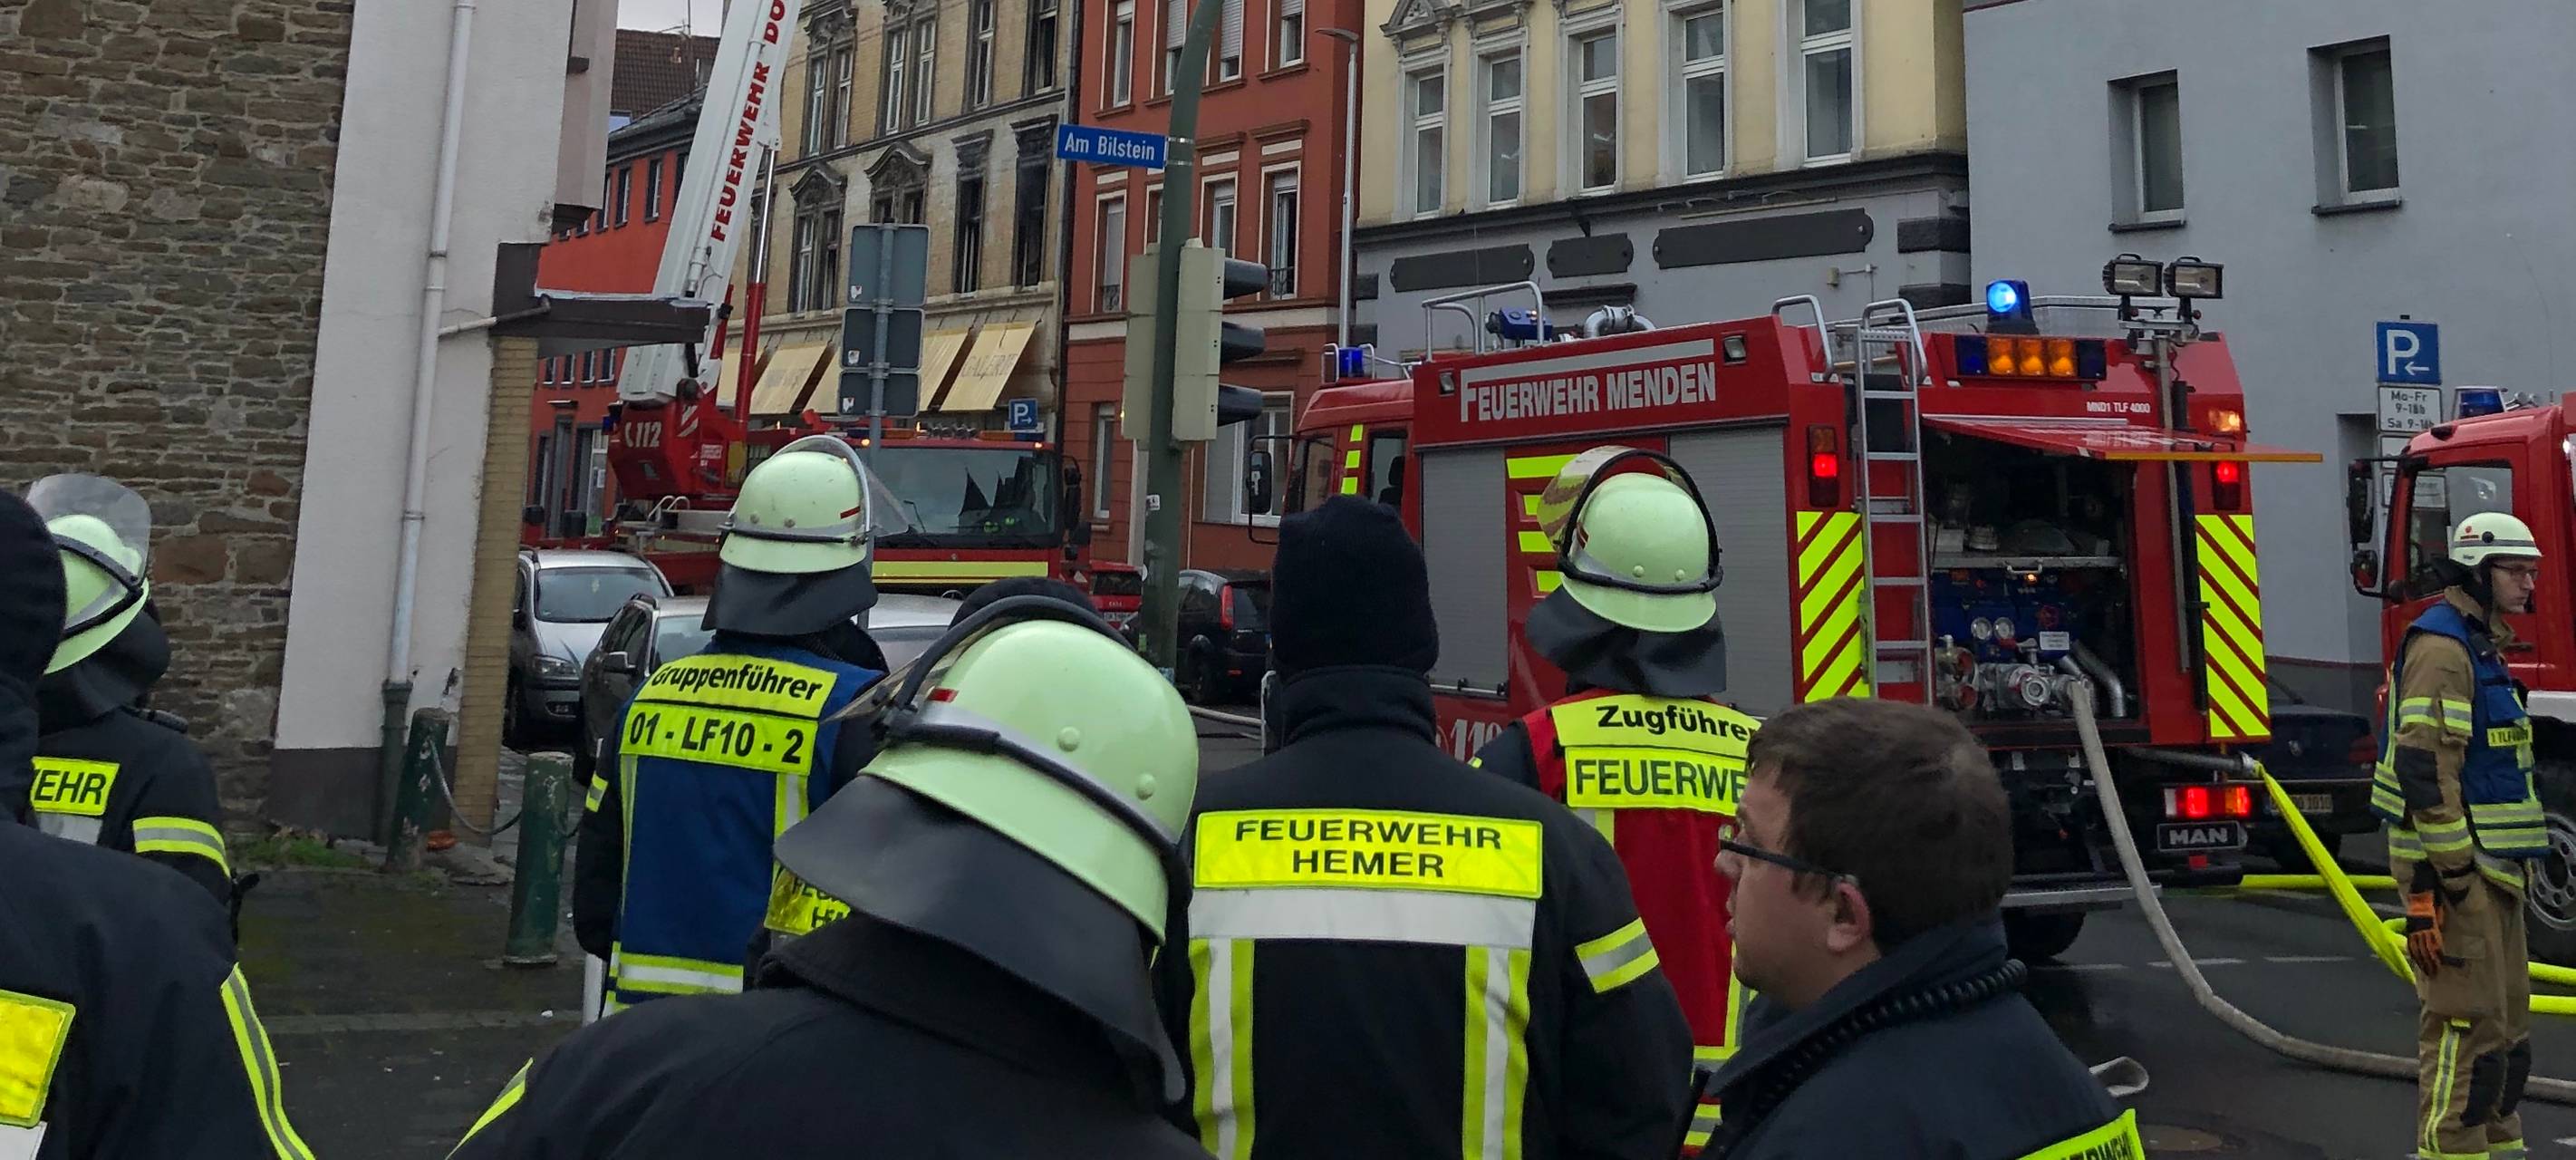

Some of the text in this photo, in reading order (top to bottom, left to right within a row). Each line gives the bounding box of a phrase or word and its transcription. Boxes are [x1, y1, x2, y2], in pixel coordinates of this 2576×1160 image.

[710, 62, 770, 242] FEUERWEHR
[1065, 132, 1155, 160] Am Bilstein
[2387, 330, 2419, 374] P
[1461, 362, 1716, 422] FEUERWEHR MENDEN
[2391, 391, 2427, 401] Mo-Fr
[2113, 402, 2128, 412] TLF
[2130, 402, 2150, 413] 4000
[635, 421, 662, 448] 112
[2388, 418, 2402, 429] Sa
[651, 662, 823, 701] Gruppenführer
[629, 711, 661, 746] 01
[681, 716, 756, 757] LF10
[781, 729, 804, 764] 2
[34, 768, 107, 806] EHR
[1234, 818, 1502, 850] FEUERWEHR
[2169, 828, 2228, 845] MAN
[1292, 849, 1444, 877] HEMER
